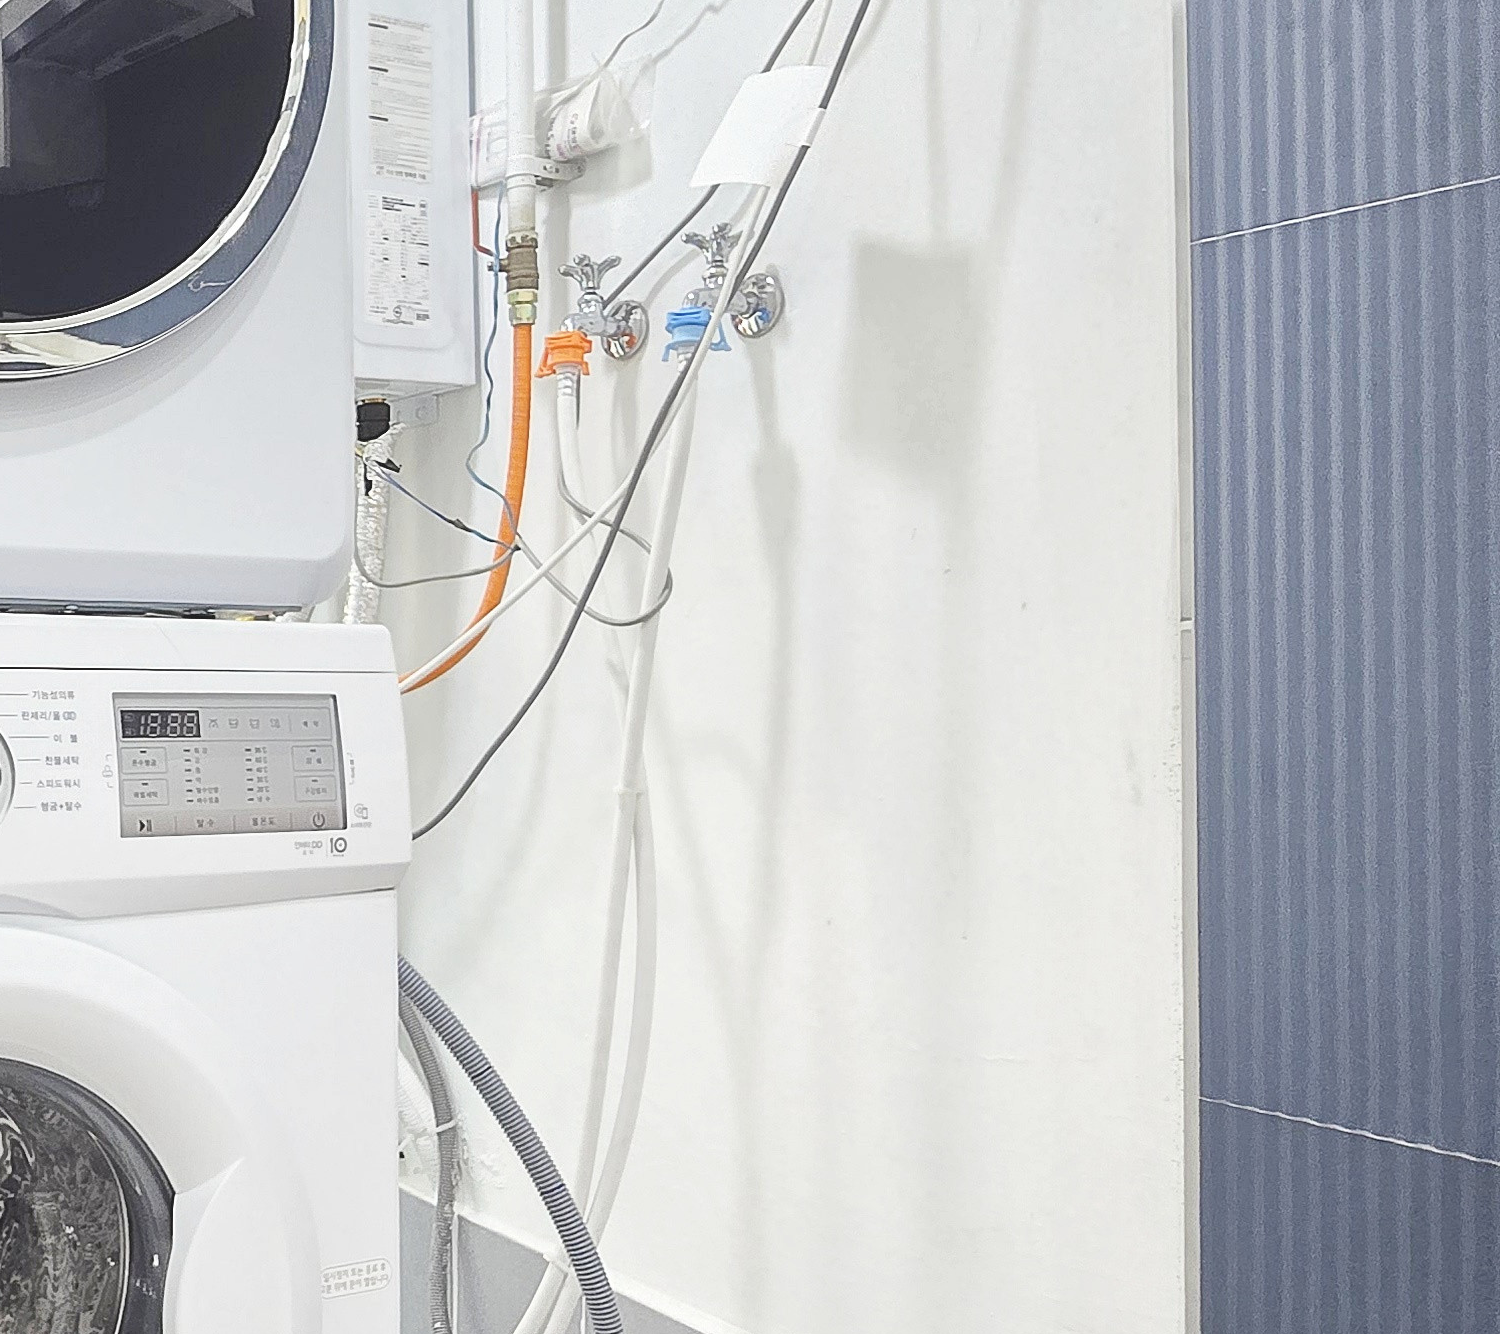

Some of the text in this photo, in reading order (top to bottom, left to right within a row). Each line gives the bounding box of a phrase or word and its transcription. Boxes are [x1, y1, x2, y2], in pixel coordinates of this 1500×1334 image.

[32, 690, 75, 700] 기능성의류
[21, 711, 61, 721] 란제리/울
[45, 756, 80, 766] 찬물세탁
[36, 779, 81, 789] 스피드워시
[41, 801, 82, 812] 헹굼+탈수
